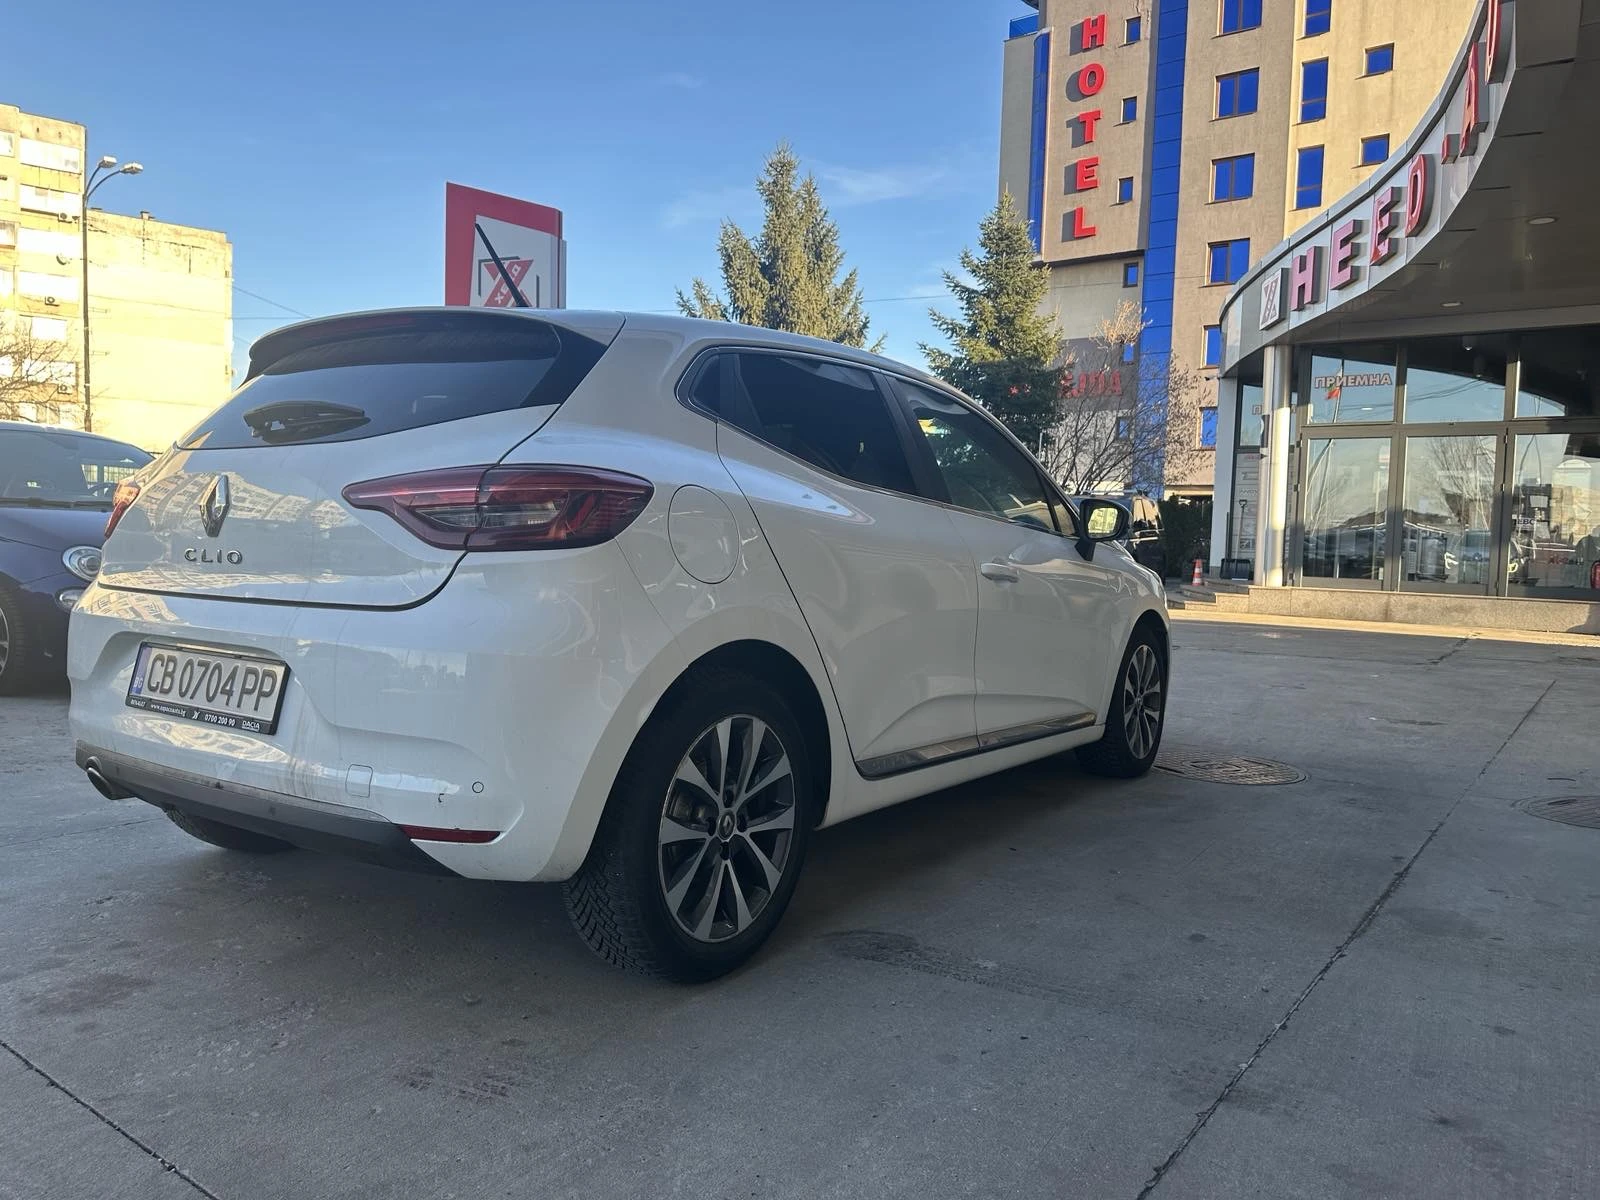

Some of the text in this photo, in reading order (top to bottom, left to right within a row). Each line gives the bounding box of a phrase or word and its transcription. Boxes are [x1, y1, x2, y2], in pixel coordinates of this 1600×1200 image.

[1073, 14, 1106, 238] HOTEL
[1315, 373, 1392, 389] ПРИЕМНА
[184, 548, 243, 565] CLIO
[147, 653, 278, 712] CB 0704 PP
[204, 713, 218, 723] 0700
[217, 716, 228, 725] 200
[242, 719, 260, 730] DACIA
